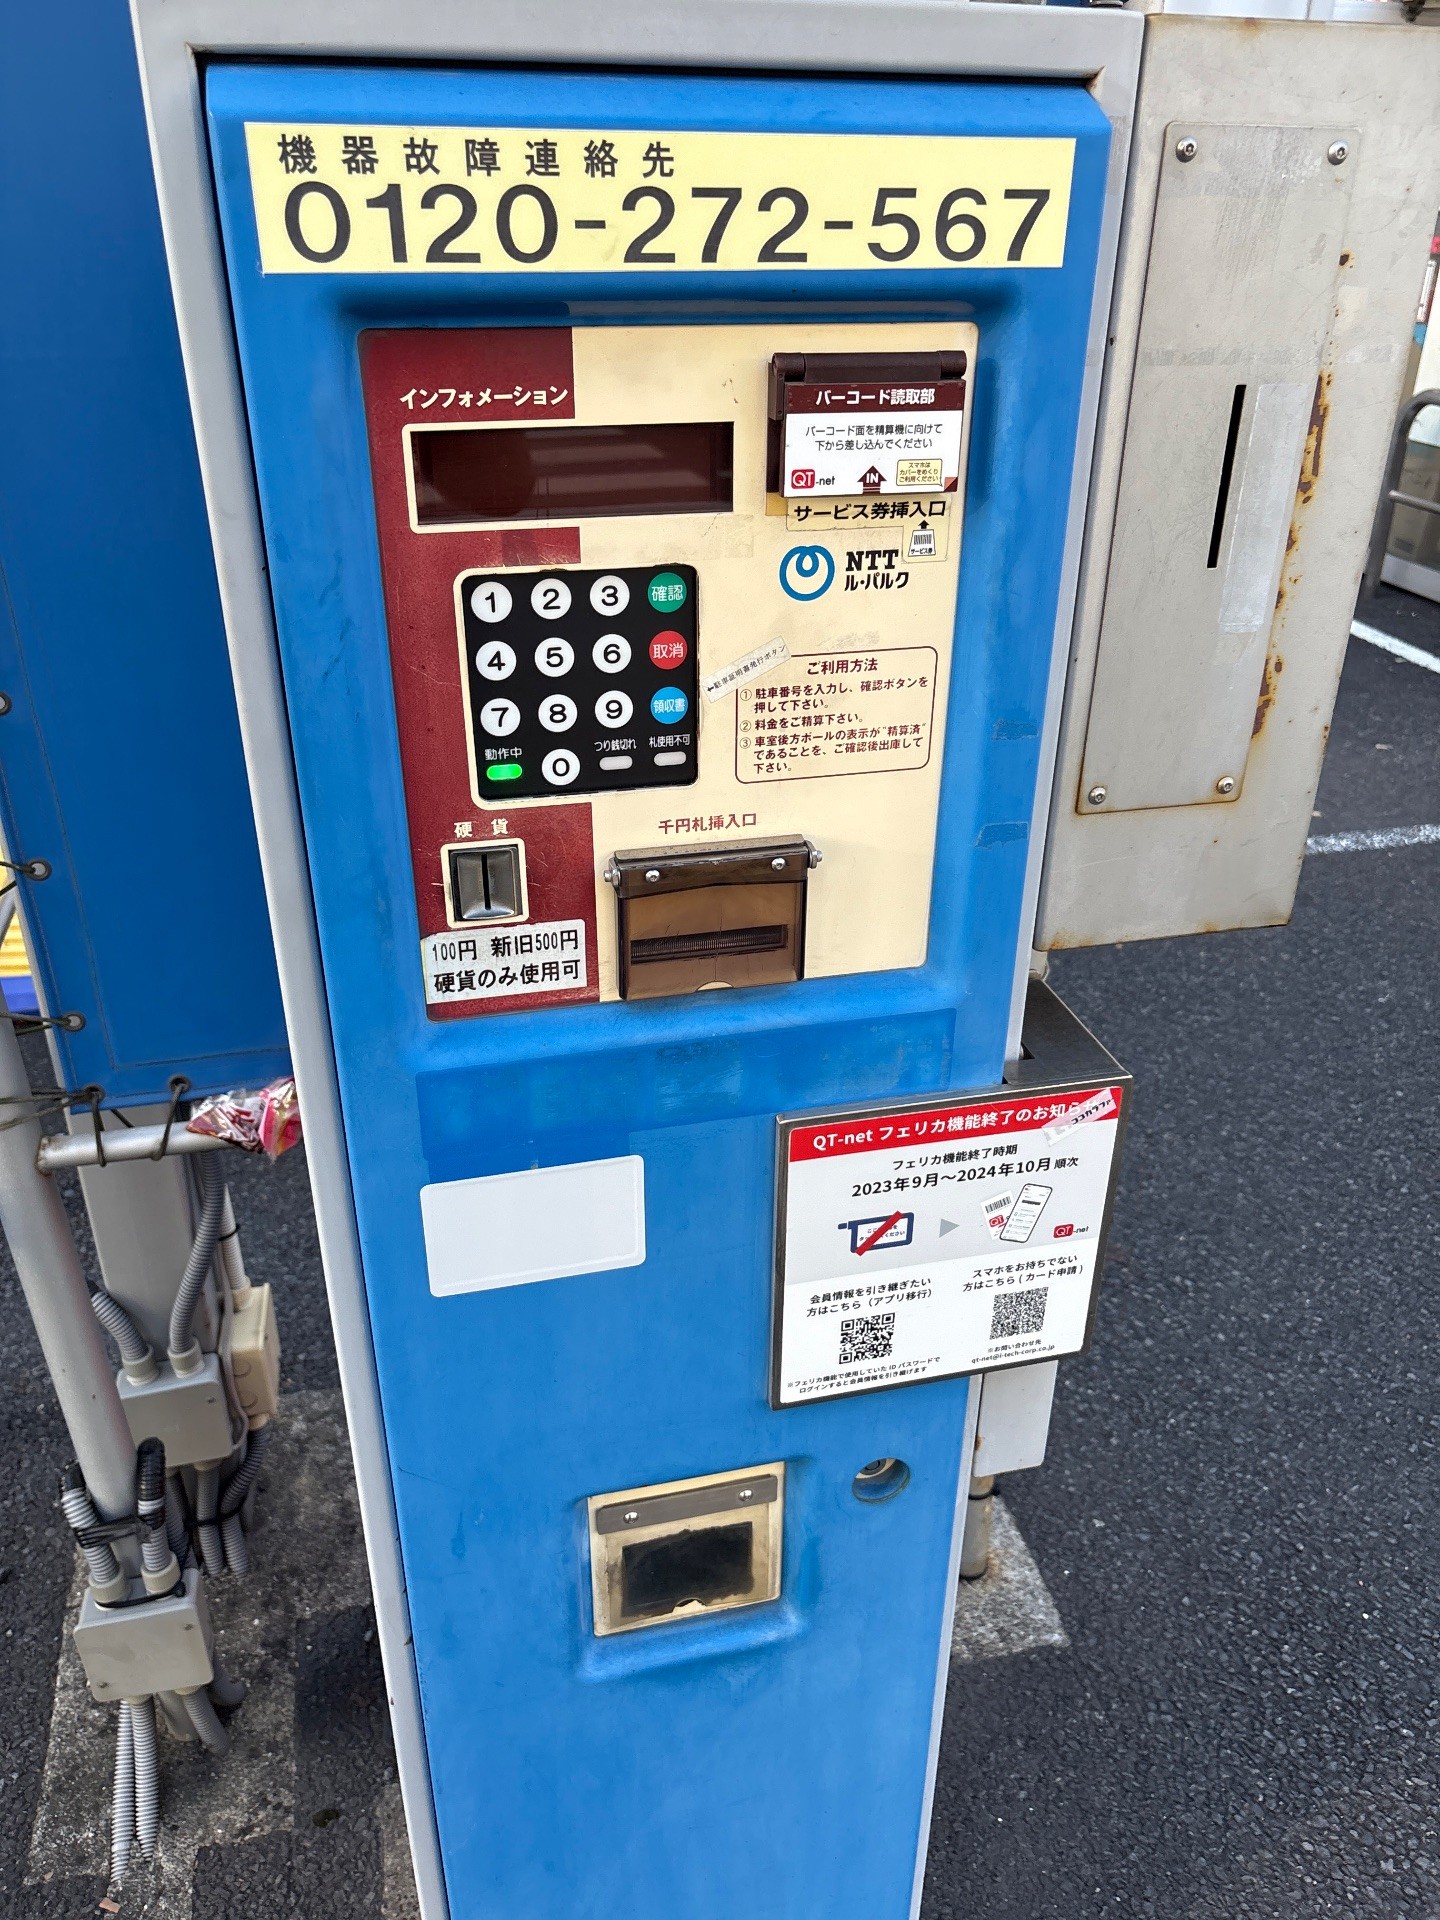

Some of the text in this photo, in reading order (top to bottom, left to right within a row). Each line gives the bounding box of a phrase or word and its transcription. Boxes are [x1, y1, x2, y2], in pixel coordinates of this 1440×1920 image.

[278, 134, 676, 177] 機器故障連絡先
[283, 180, 1052, 264] 0120-272-567
[400, 386, 569, 409] インフォメーション
[816, 388, 935, 406] バーコード読取部
[805, 423, 943, 437] バーコード面を精算機に向けて
[815, 438, 933, 451] 下から差し込んでください
[791, 470, 835, 488] QT-net
[866, 472, 879, 484] IN
[794, 500, 947, 522] サービス券挿入口
[846, 549, 899, 572] NTT
[844, 571, 910, 592] ル・パルク
[484, 592, 496, 613] 1
[542, 588, 561, 610] 2
[601, 585, 619, 606] 3
[651, 585, 684, 602] 確認
[487, 650, 506, 671] 4
[546, 647, 564, 667] 5
[603, 643, 621, 664] 6
[653, 643, 684, 659] 取消
[807, 658, 878, 675] ご利用方法
[755, 676, 929, 699] 駐車番号を入力し、確認ボタンを
[549, 703, 567, 723] 8
[605, 699, 623, 719] 9
[653, 698, 685, 714] 領収書
[754, 699, 829, 714] 押して下さい。
[491, 707, 509, 727] 7
[754, 712, 863, 731] 料金をご精算下さい。
[594, 738, 637, 752] つり銭切れ
[649, 733, 690, 748] 札使用不可
[754, 736, 923, 761] であることを、ご確認後出庫して
[484, 747, 523, 761] 動作中
[552, 757, 570, 777] 0
[754, 762, 792, 774] 下さい。
[454, 818, 509, 838] 硬貨
[658, 813, 757, 834] 千円札挿入口
[431, 929, 579, 962] 100円 新旧500円
[433, 959, 580, 993] 硬貨のみ使用可
[1071, 1098, 1114, 1125] ココカラファ
[813, 1128, 874, 1151] QT-net
[892, 1143, 1018, 1170] フェリカ機能終了時期
[1053, 1156, 1079, 1170] 順次
[1054, 1224, 1090, 1238] QT-net
[973, 1255, 1077, 1278] スマホをお持ちでない
[810, 1278, 931, 1304] 会員情報を引き継ぎたい
[799, 1366, 928, 1394] ログインすると会員情報を引き継げます
